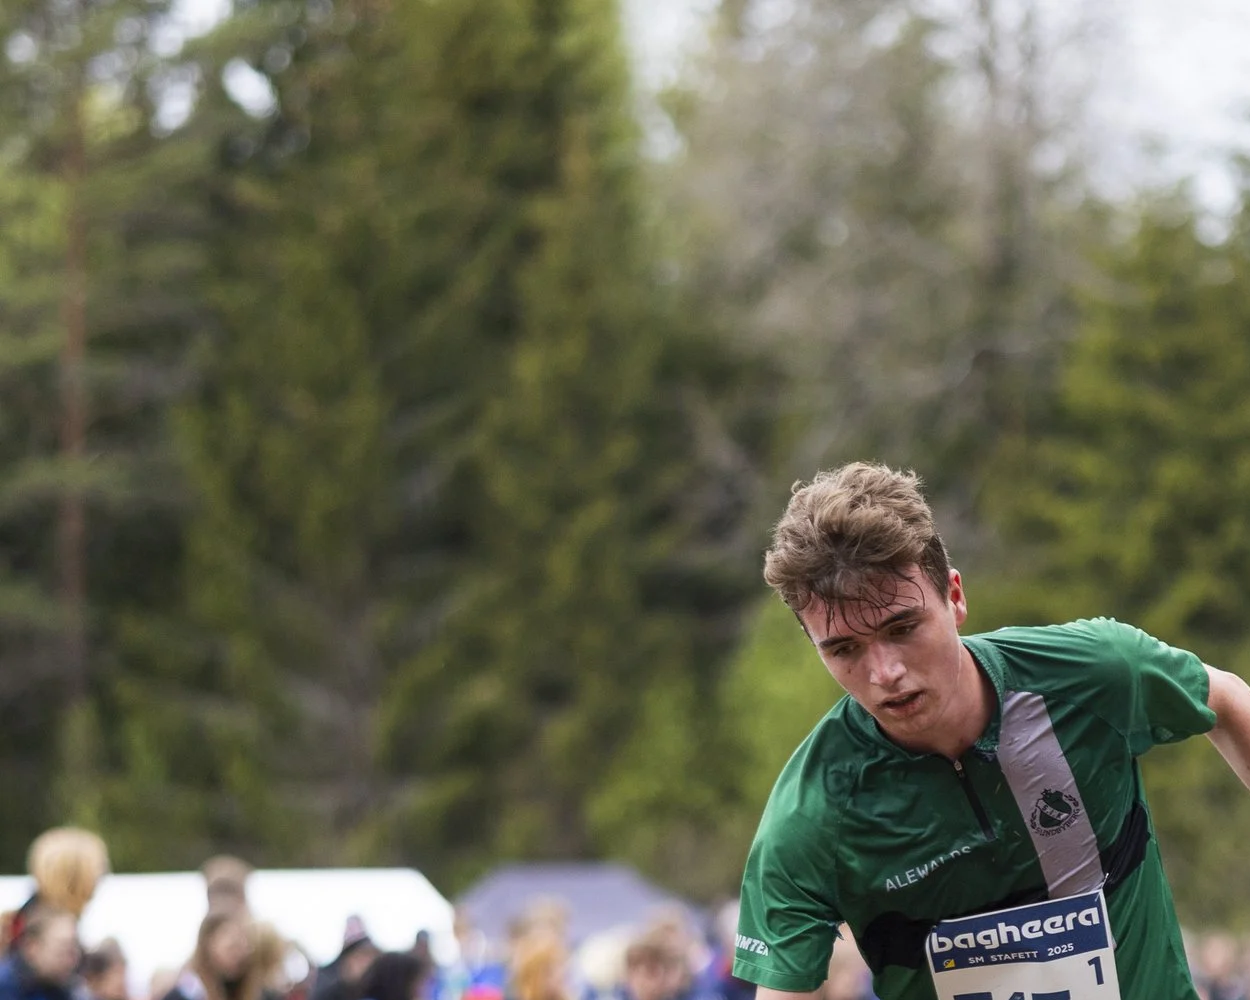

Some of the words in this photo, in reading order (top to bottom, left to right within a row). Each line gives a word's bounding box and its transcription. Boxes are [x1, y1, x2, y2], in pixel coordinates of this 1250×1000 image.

[931, 906, 1100, 954] bagheera
[968, 956, 985, 965] SM
[990, 950, 1038, 963] STAFETT
[1047, 942, 1074, 957] 2025
[1088, 955, 1105, 985] 1
